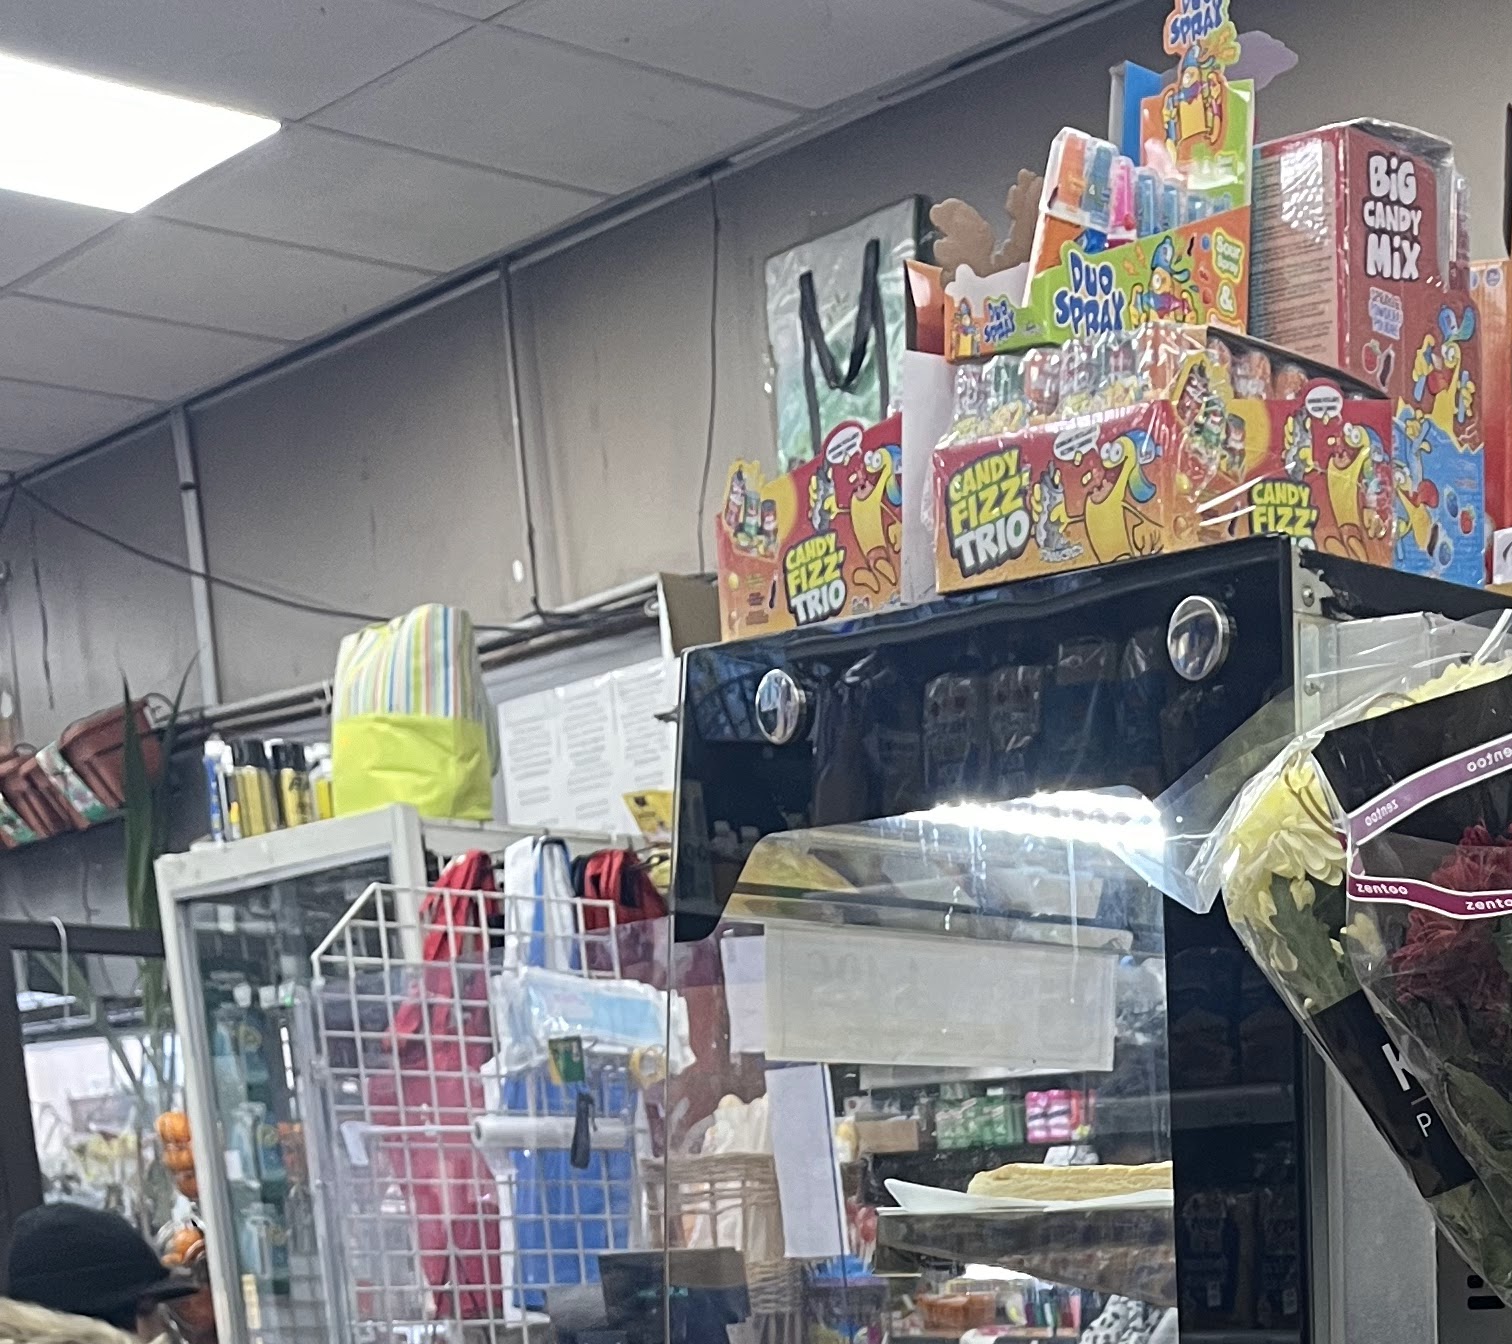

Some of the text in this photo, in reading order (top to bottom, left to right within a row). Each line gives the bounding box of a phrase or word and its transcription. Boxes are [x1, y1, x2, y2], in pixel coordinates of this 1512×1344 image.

[1363, 200, 1422, 236] CANDY
[1069, 250, 1113, 297] DUO
[1054, 290, 1125, 335] SPRAY
[949, 448, 1020, 499] CANDY
[1251, 481, 1311, 509] CANDY
[786, 533, 838, 570] CANDY
[956, 510, 1031, 568] TRIO
[791, 580, 847, 621] TRIO
[1355, 882, 1409, 895] zentoo
[1416, 1112, 1432, 1138] P
